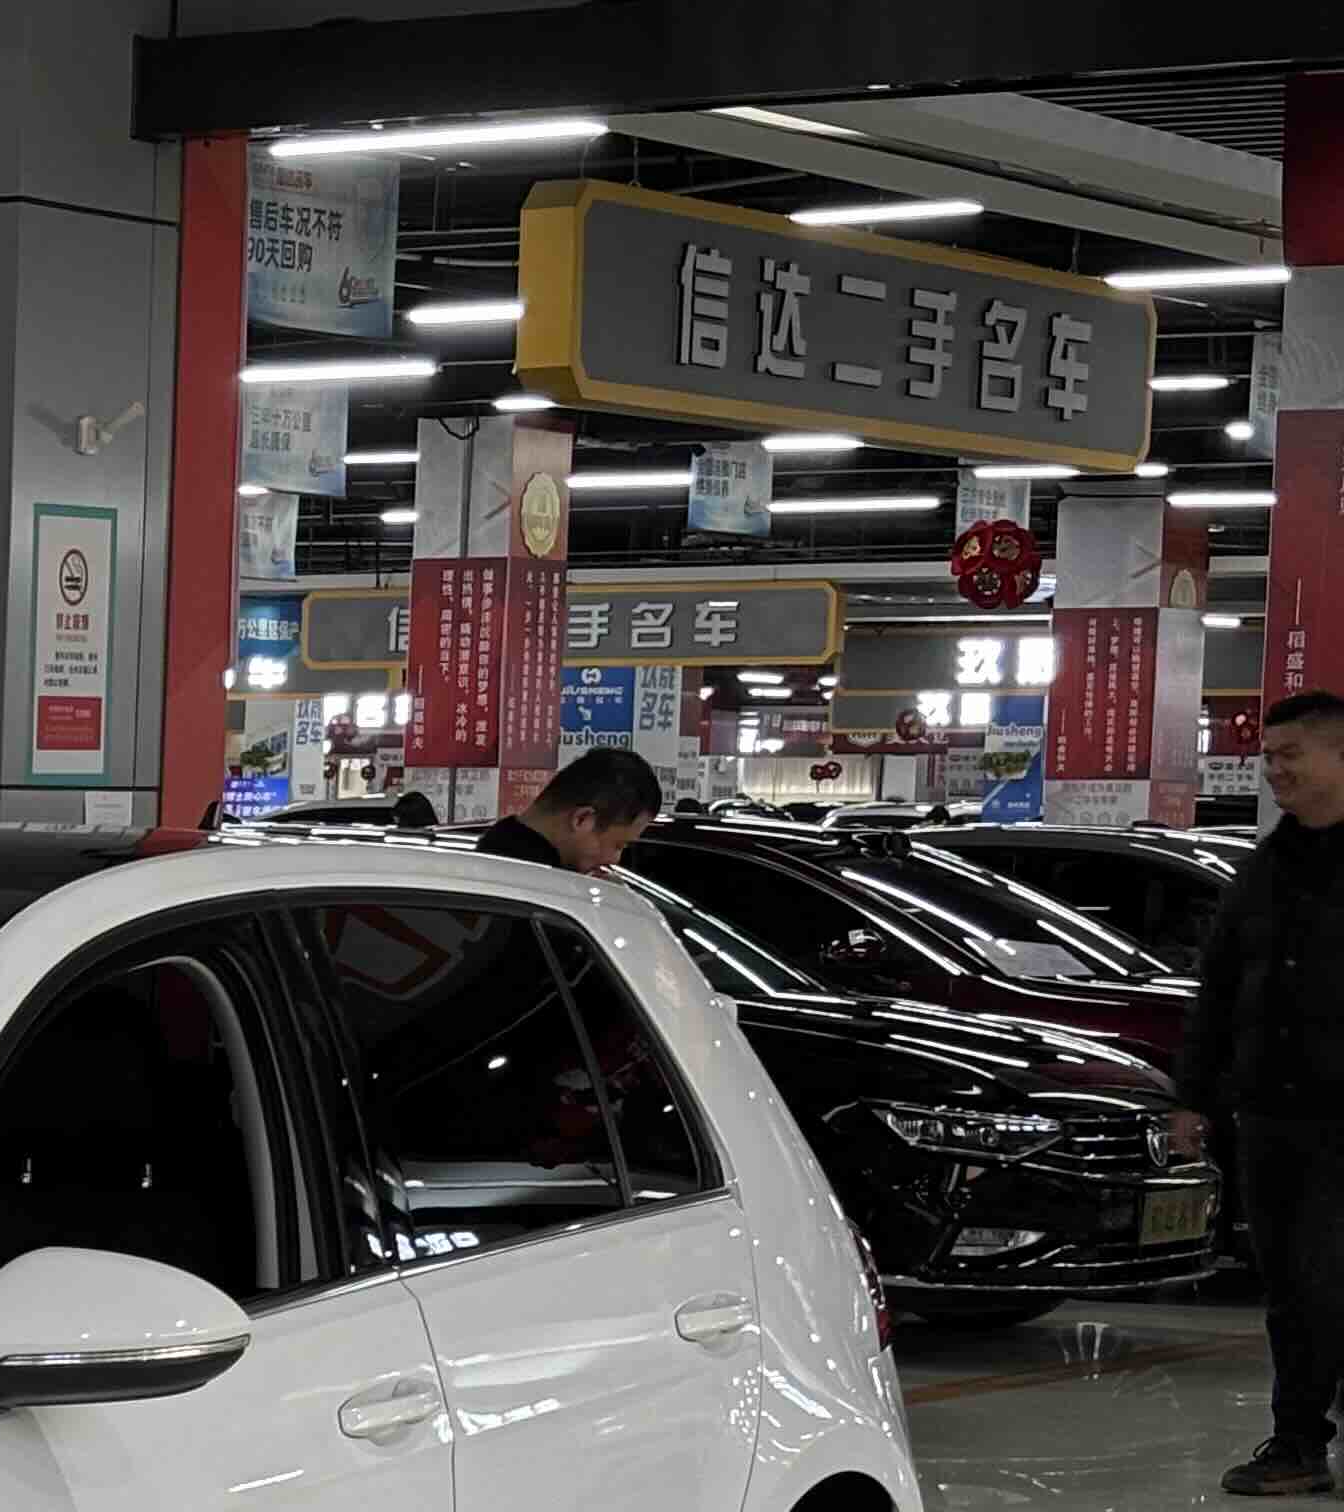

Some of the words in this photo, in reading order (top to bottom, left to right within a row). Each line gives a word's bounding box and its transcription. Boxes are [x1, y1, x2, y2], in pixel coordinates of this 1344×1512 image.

[250, 198, 343, 241] 售后车况不符
[248, 237, 313, 272] 90天回购
[678, 242, 1091, 421] 信达二手名车
